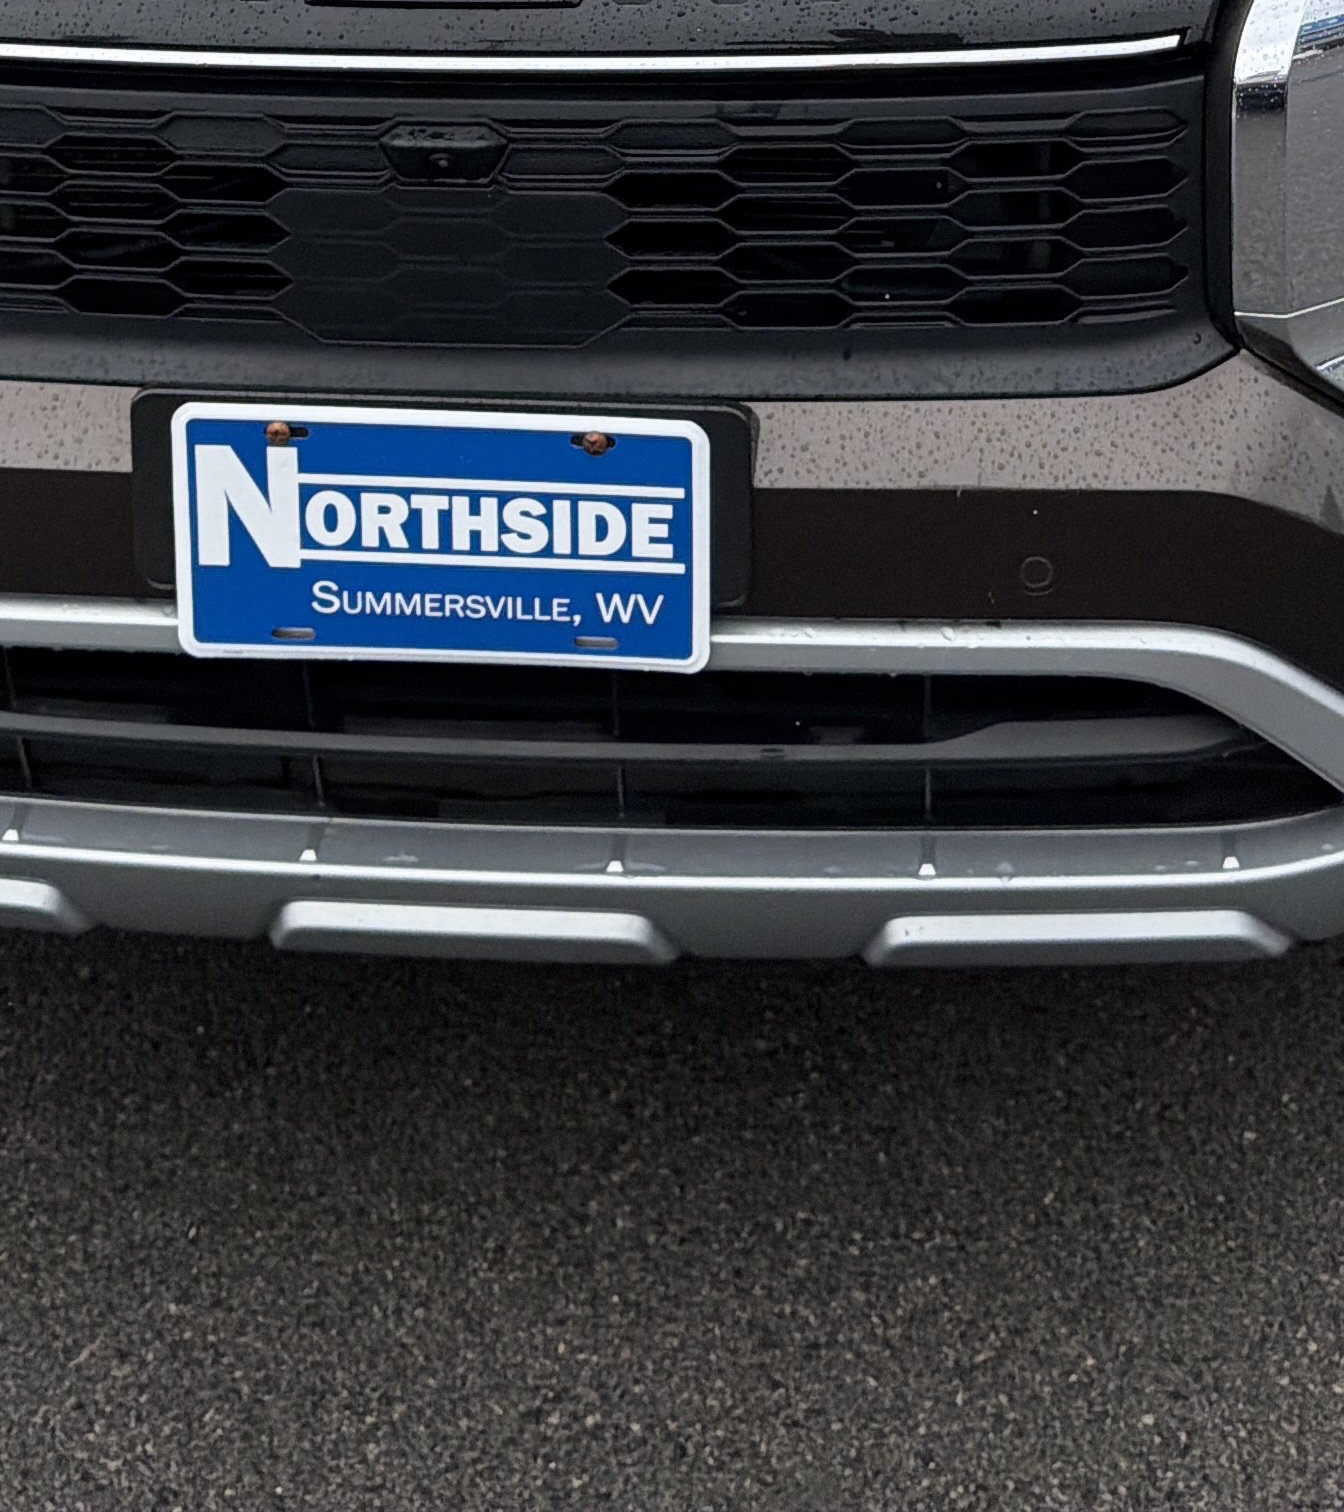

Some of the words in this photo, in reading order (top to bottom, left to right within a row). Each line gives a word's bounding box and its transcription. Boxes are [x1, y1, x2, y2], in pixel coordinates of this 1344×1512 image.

[194, 443, 675, 569] NORTHSIDE
[310, 579, 584, 628] SUMMERSVILLE,
[595, 592, 665, 626] WV
